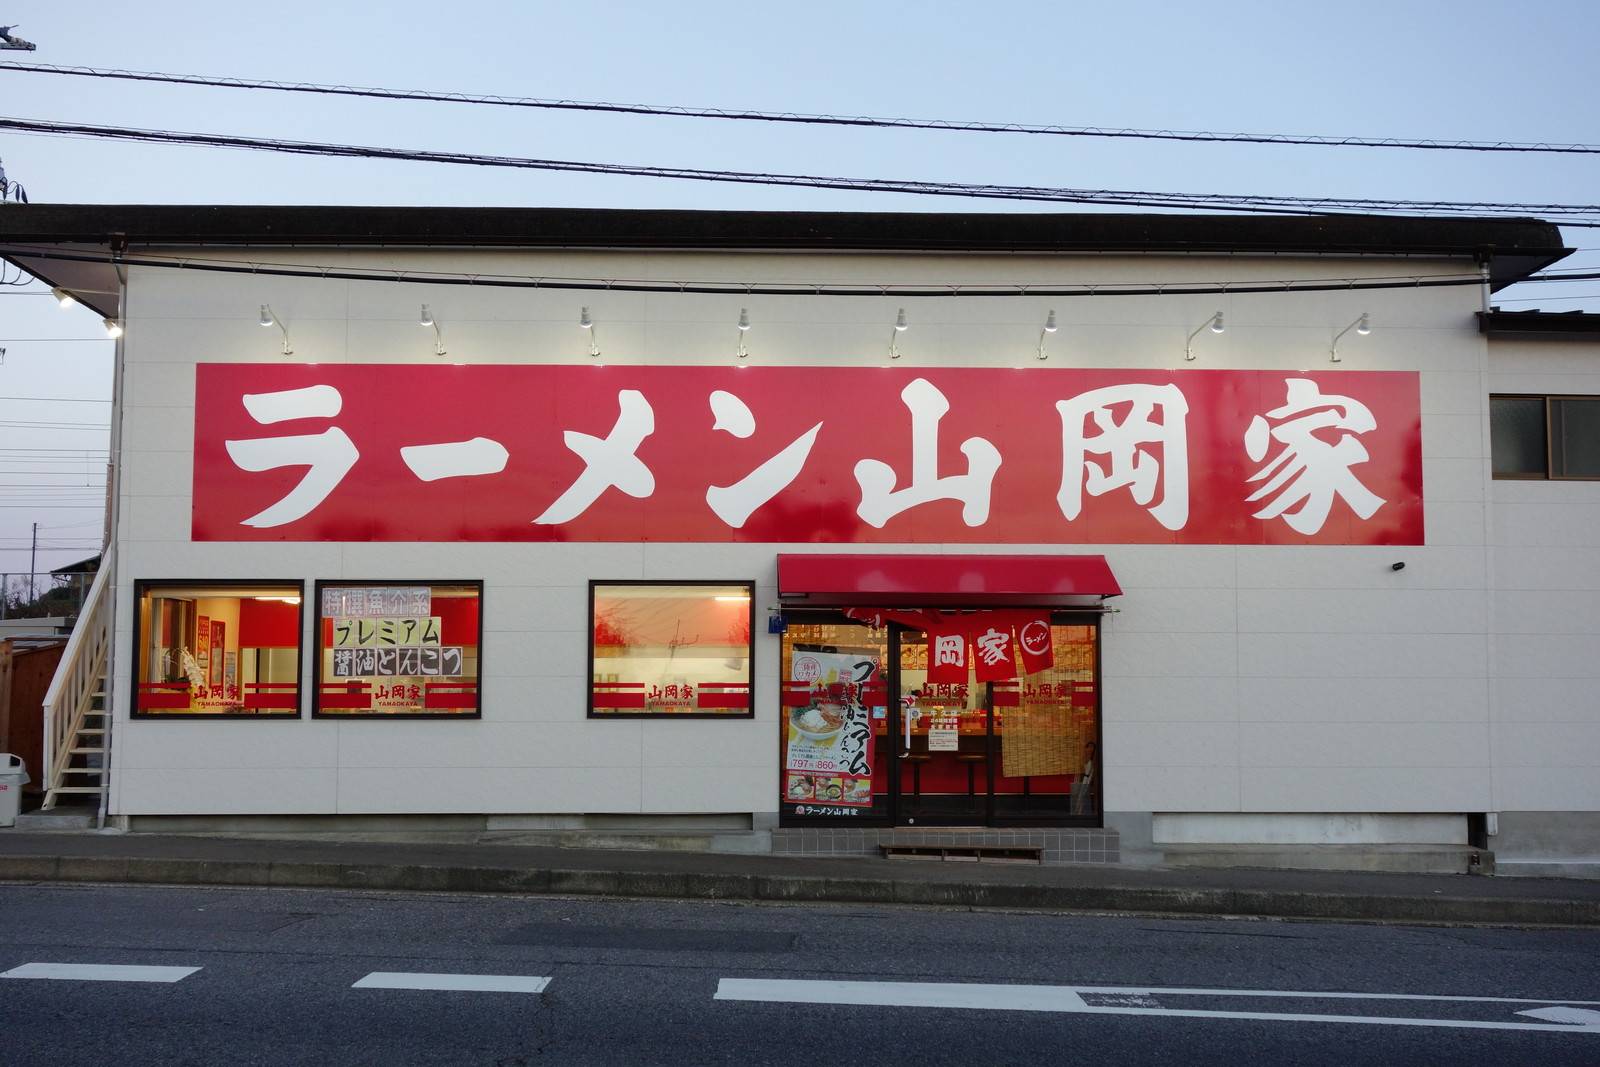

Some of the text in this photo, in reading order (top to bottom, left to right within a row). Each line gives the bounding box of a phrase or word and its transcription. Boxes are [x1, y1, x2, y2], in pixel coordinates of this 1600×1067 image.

[225, 378, 1387, 535] ラーメン山岡家
[336, 620, 439, 645] プレミアム
[1025, 632, 1047, 646] ラーメン
[335, 649, 461, 675] 醤油とんこつ
[194, 685, 240, 699] 山岡家
[375, 684, 421, 699] 山岡家
[648, 685, 693, 699] 山岡家
[919, 682, 969, 698] 山岡家
[1023, 683, 1066, 698] 山岡家
[806, 806, 859, 816] ラーメン山岡家
